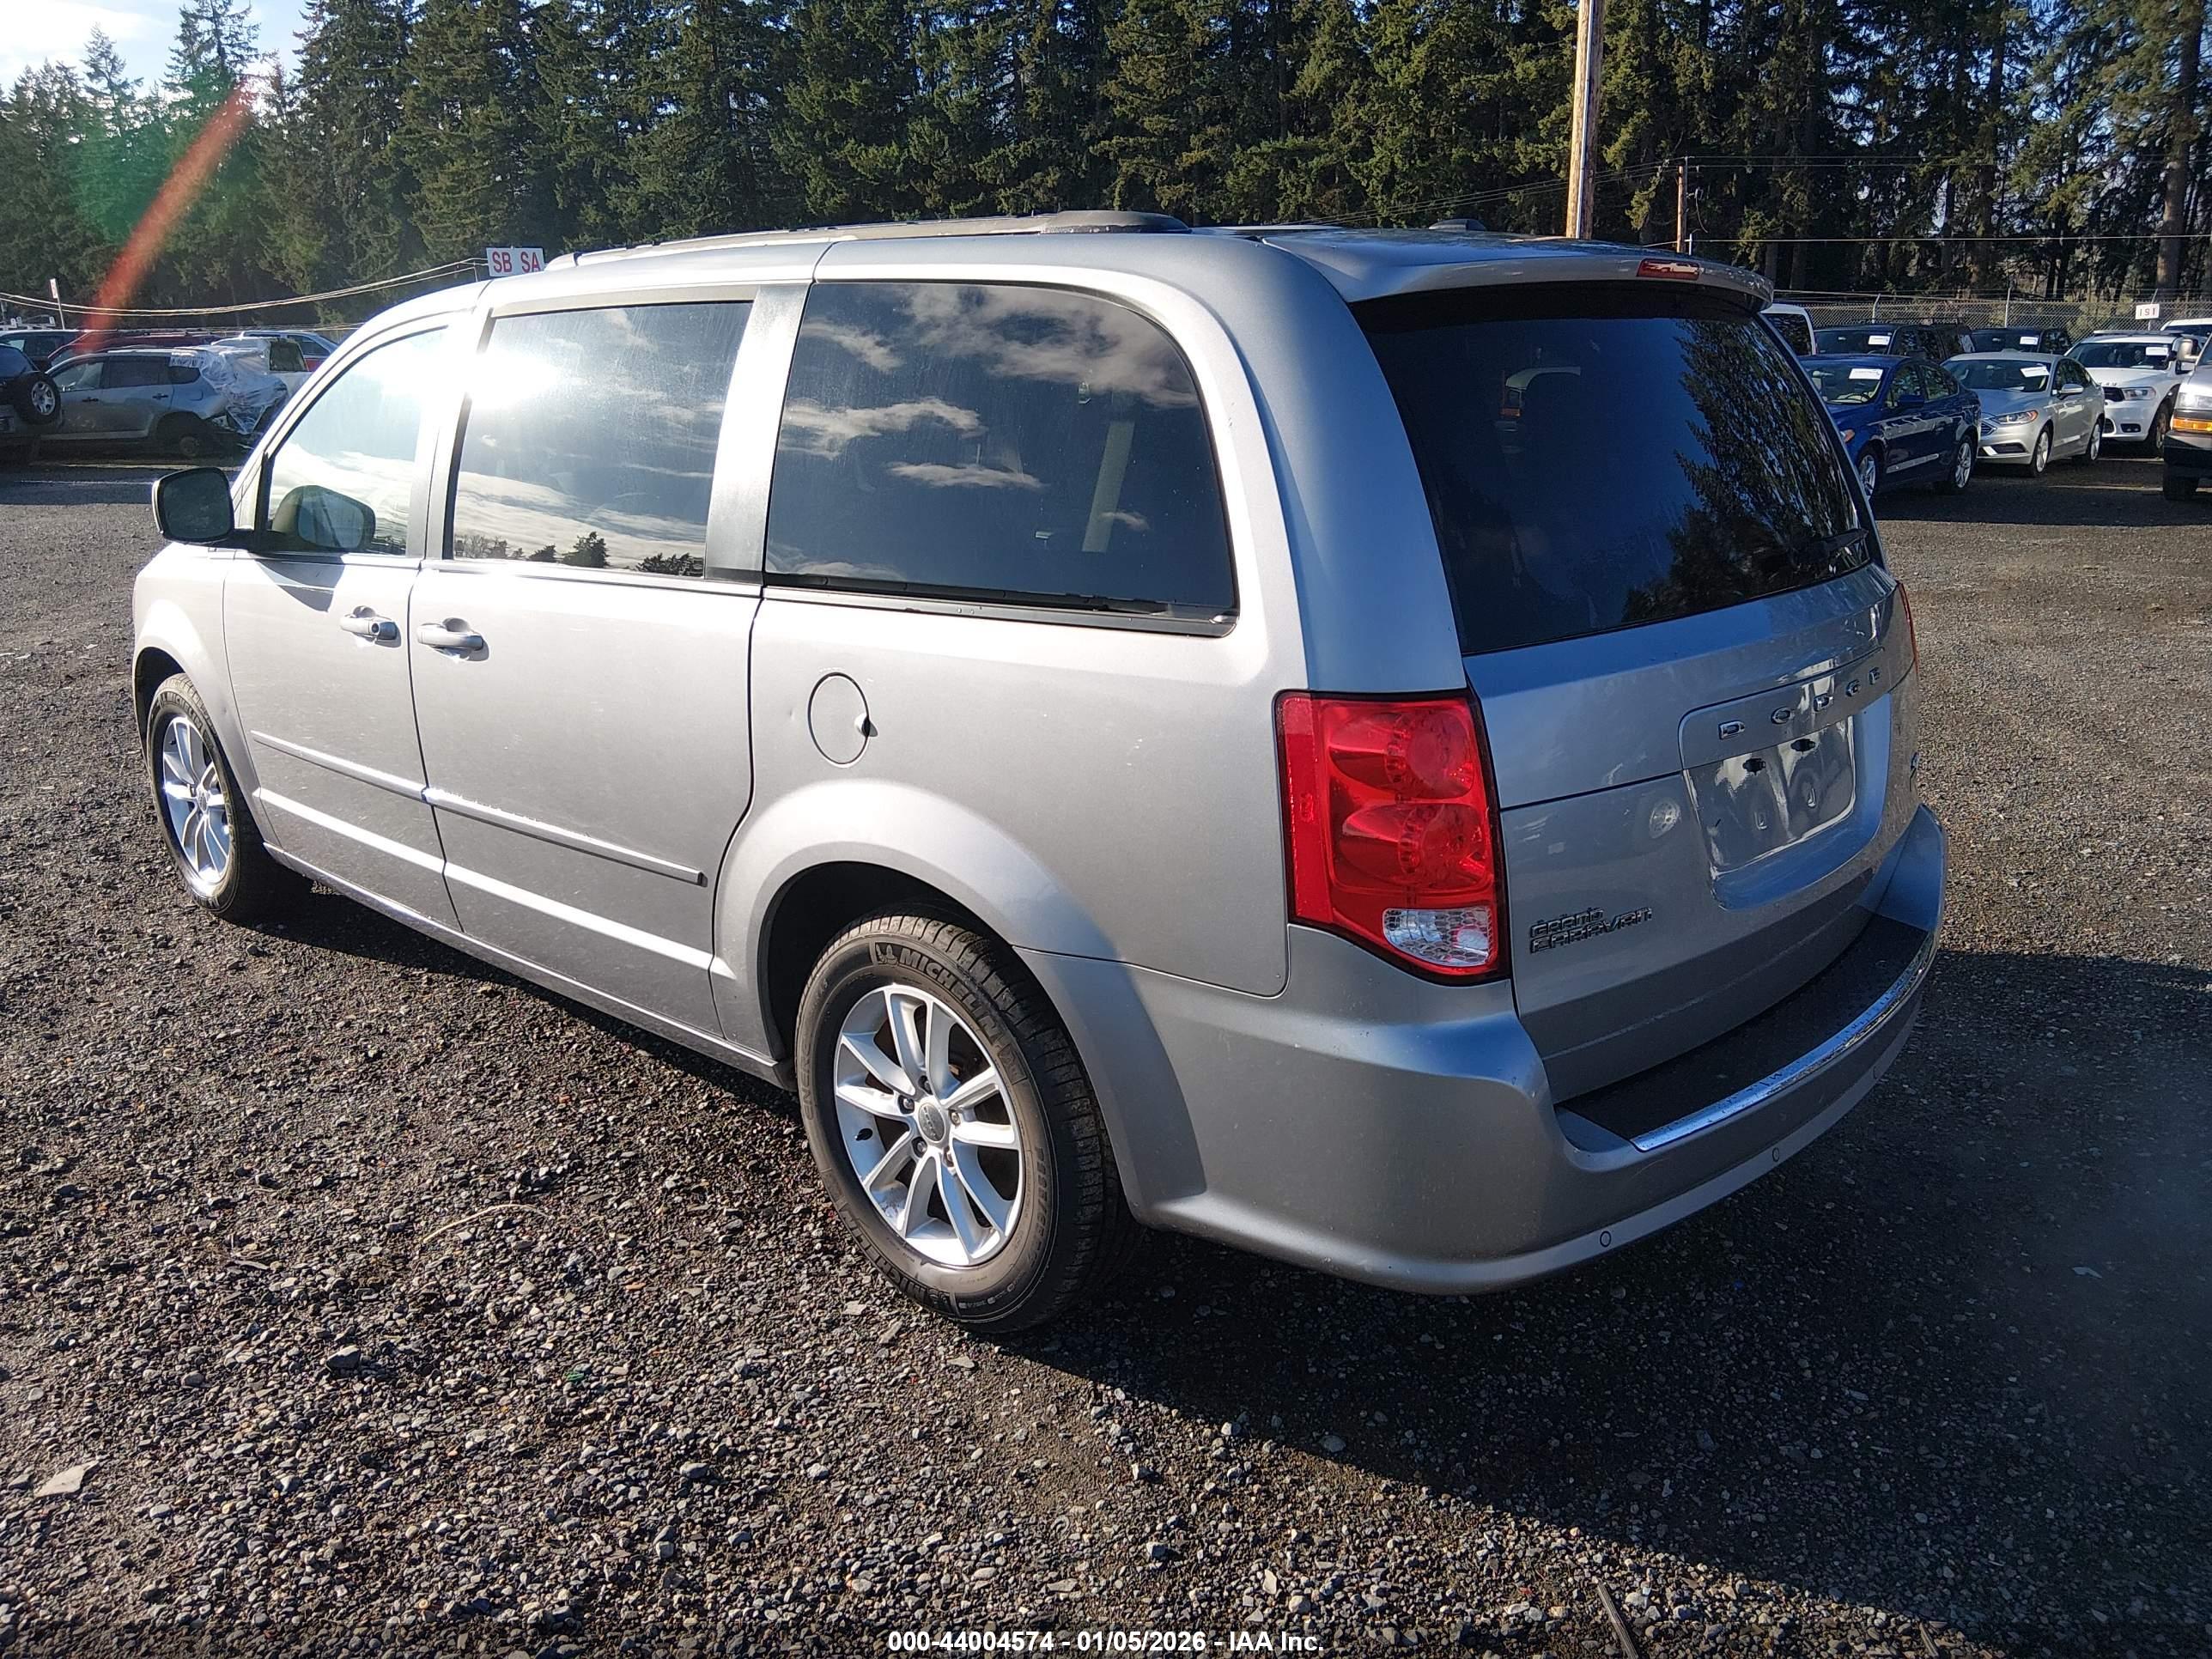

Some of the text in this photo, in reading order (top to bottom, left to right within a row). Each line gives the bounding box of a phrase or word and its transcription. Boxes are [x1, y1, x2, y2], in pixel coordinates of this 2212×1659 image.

[492, 251, 541, 273] SB SA
[1718, 666, 1881, 740] DODGE
[899, 946, 1006, 1046] MICHELIN
